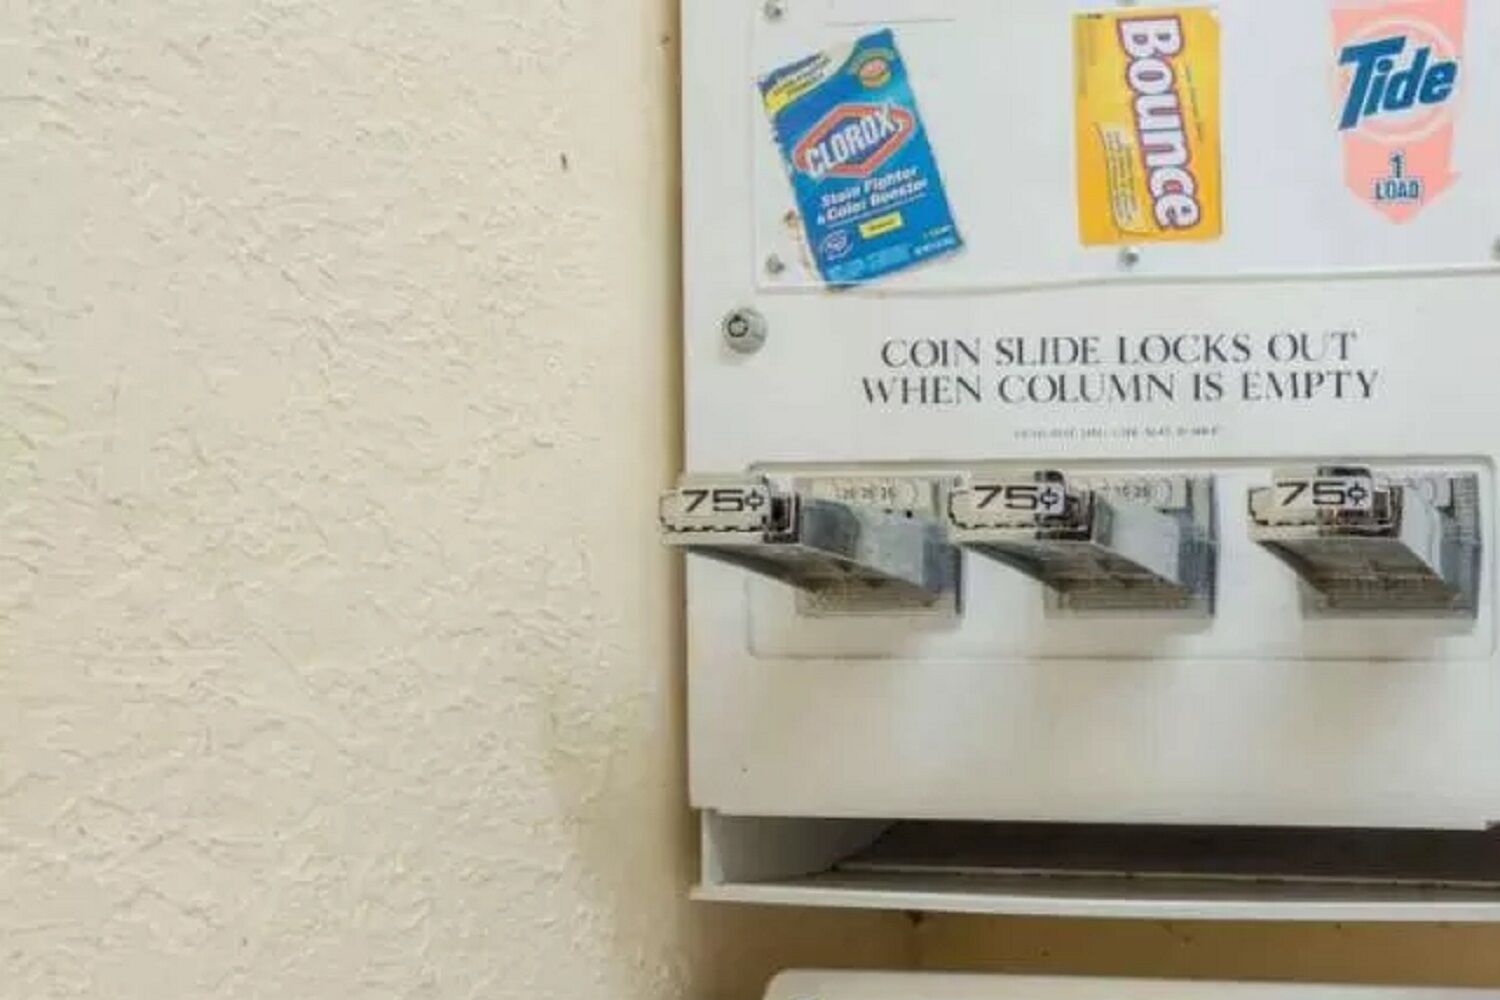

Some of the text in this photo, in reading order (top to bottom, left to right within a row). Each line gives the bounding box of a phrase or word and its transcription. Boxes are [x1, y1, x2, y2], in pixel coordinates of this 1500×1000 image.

[1338, 35, 1458, 131] Tide
[804, 101, 898, 178] CLOROX
[1116, 16, 1201, 231] Bounce
[1390, 153, 1402, 179] 1
[821, 166, 920, 208] Stain Fighter
[826, 201, 867, 221] Color
[870, 178, 929, 206] Booster
[1375, 180, 1420, 200] LOAD
[881, 330, 1358, 369] COIN SLIDE LOCKS OUT
[862, 369, 1379, 405] WHEN COLUMN IS EMPTY
[681, 488, 765, 513] 75¢
[973, 484, 1060, 510] 75¢
[1277, 480, 1369, 506] 75¢
